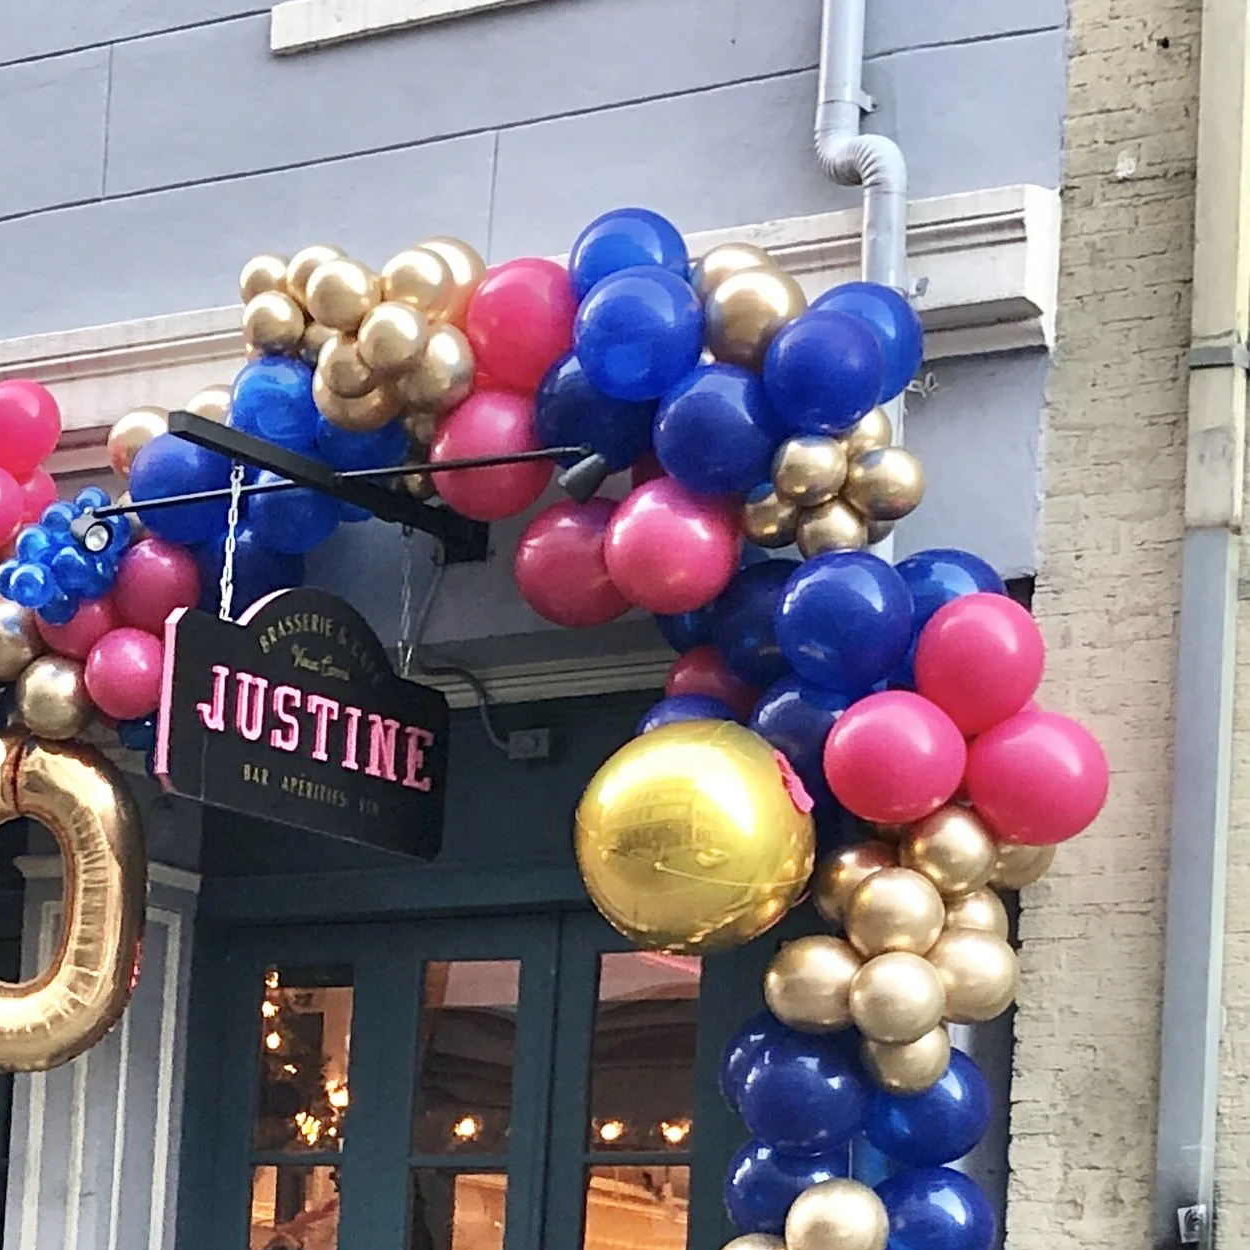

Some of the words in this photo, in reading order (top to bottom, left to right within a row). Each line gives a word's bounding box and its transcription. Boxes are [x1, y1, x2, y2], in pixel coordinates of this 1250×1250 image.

[259, 613, 333, 654] BRASSERIE
[196, 664, 435, 793] JUSTINE
[243, 763, 270, 786] BAR
